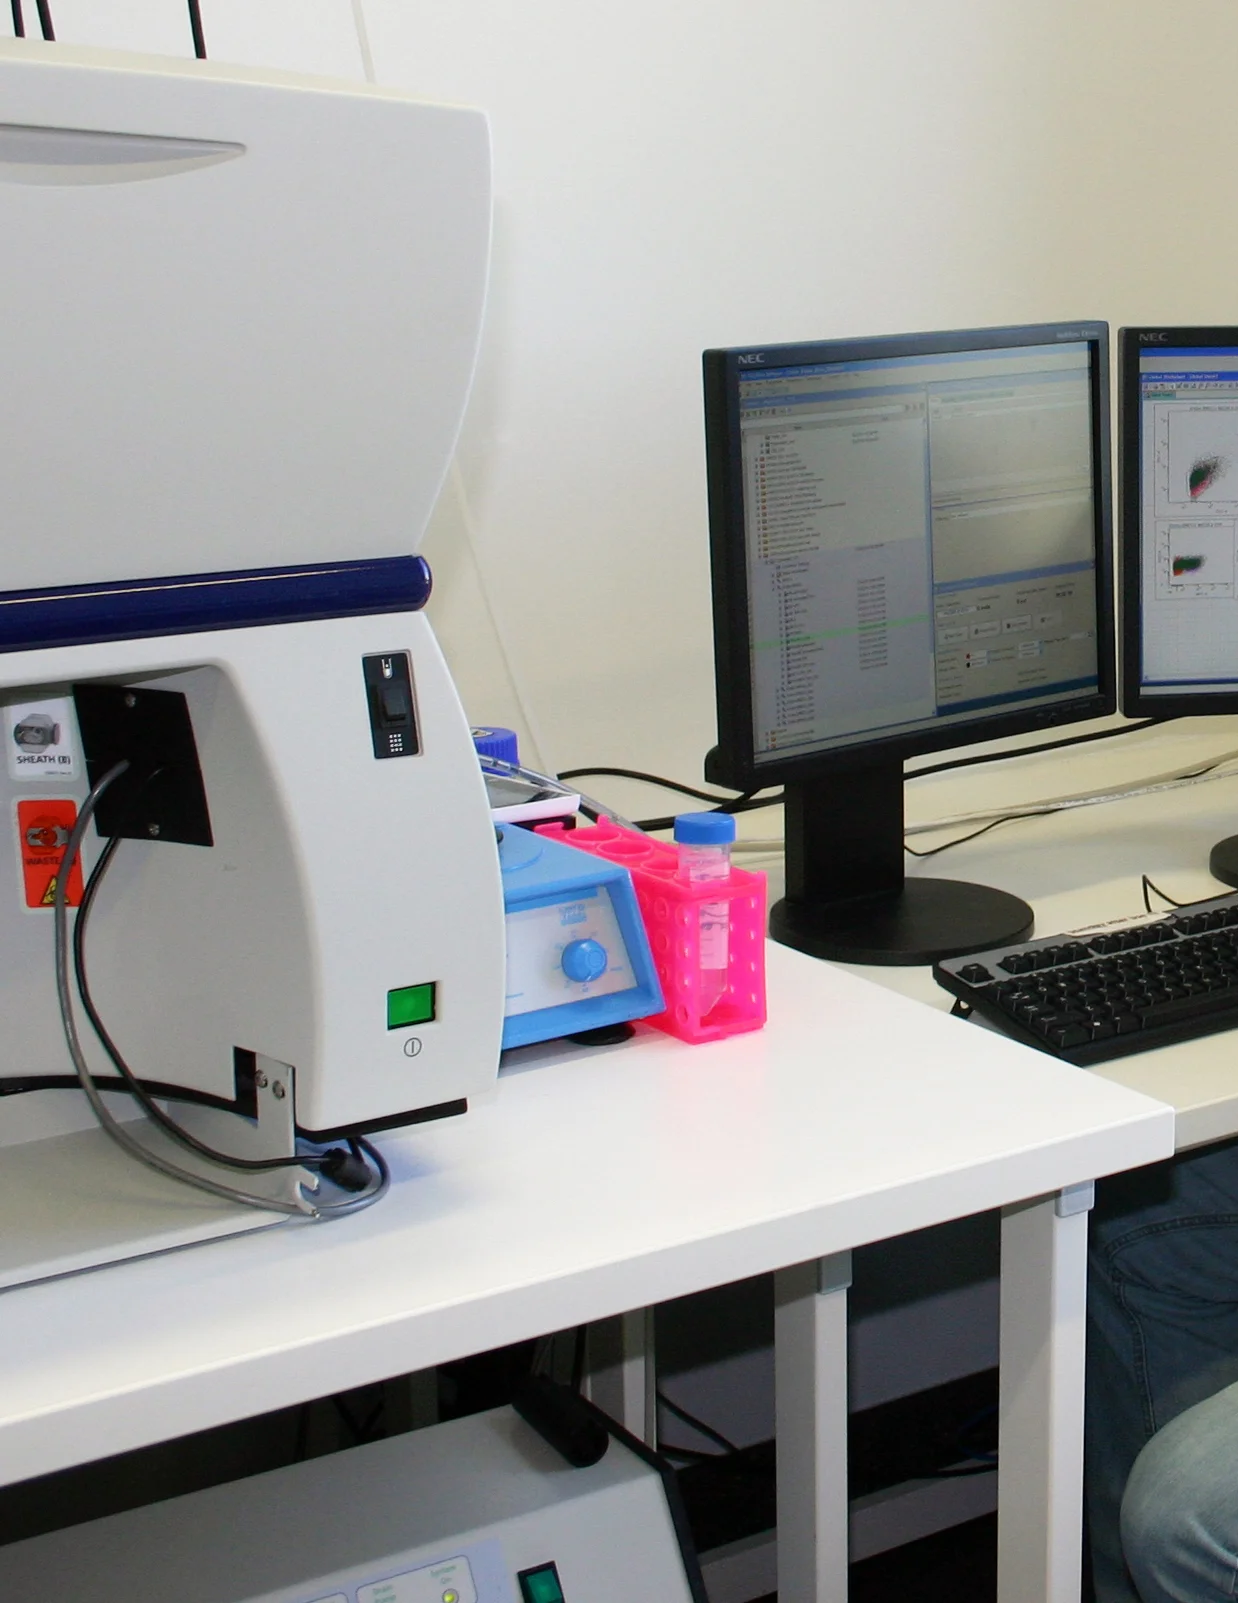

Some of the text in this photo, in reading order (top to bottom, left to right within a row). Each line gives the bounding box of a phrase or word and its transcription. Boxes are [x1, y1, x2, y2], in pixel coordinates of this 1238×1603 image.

[1139, 332, 1169, 342] NEC
[737, 352, 765, 365] NEC
[16, 755, 56, 764] SHEATH
